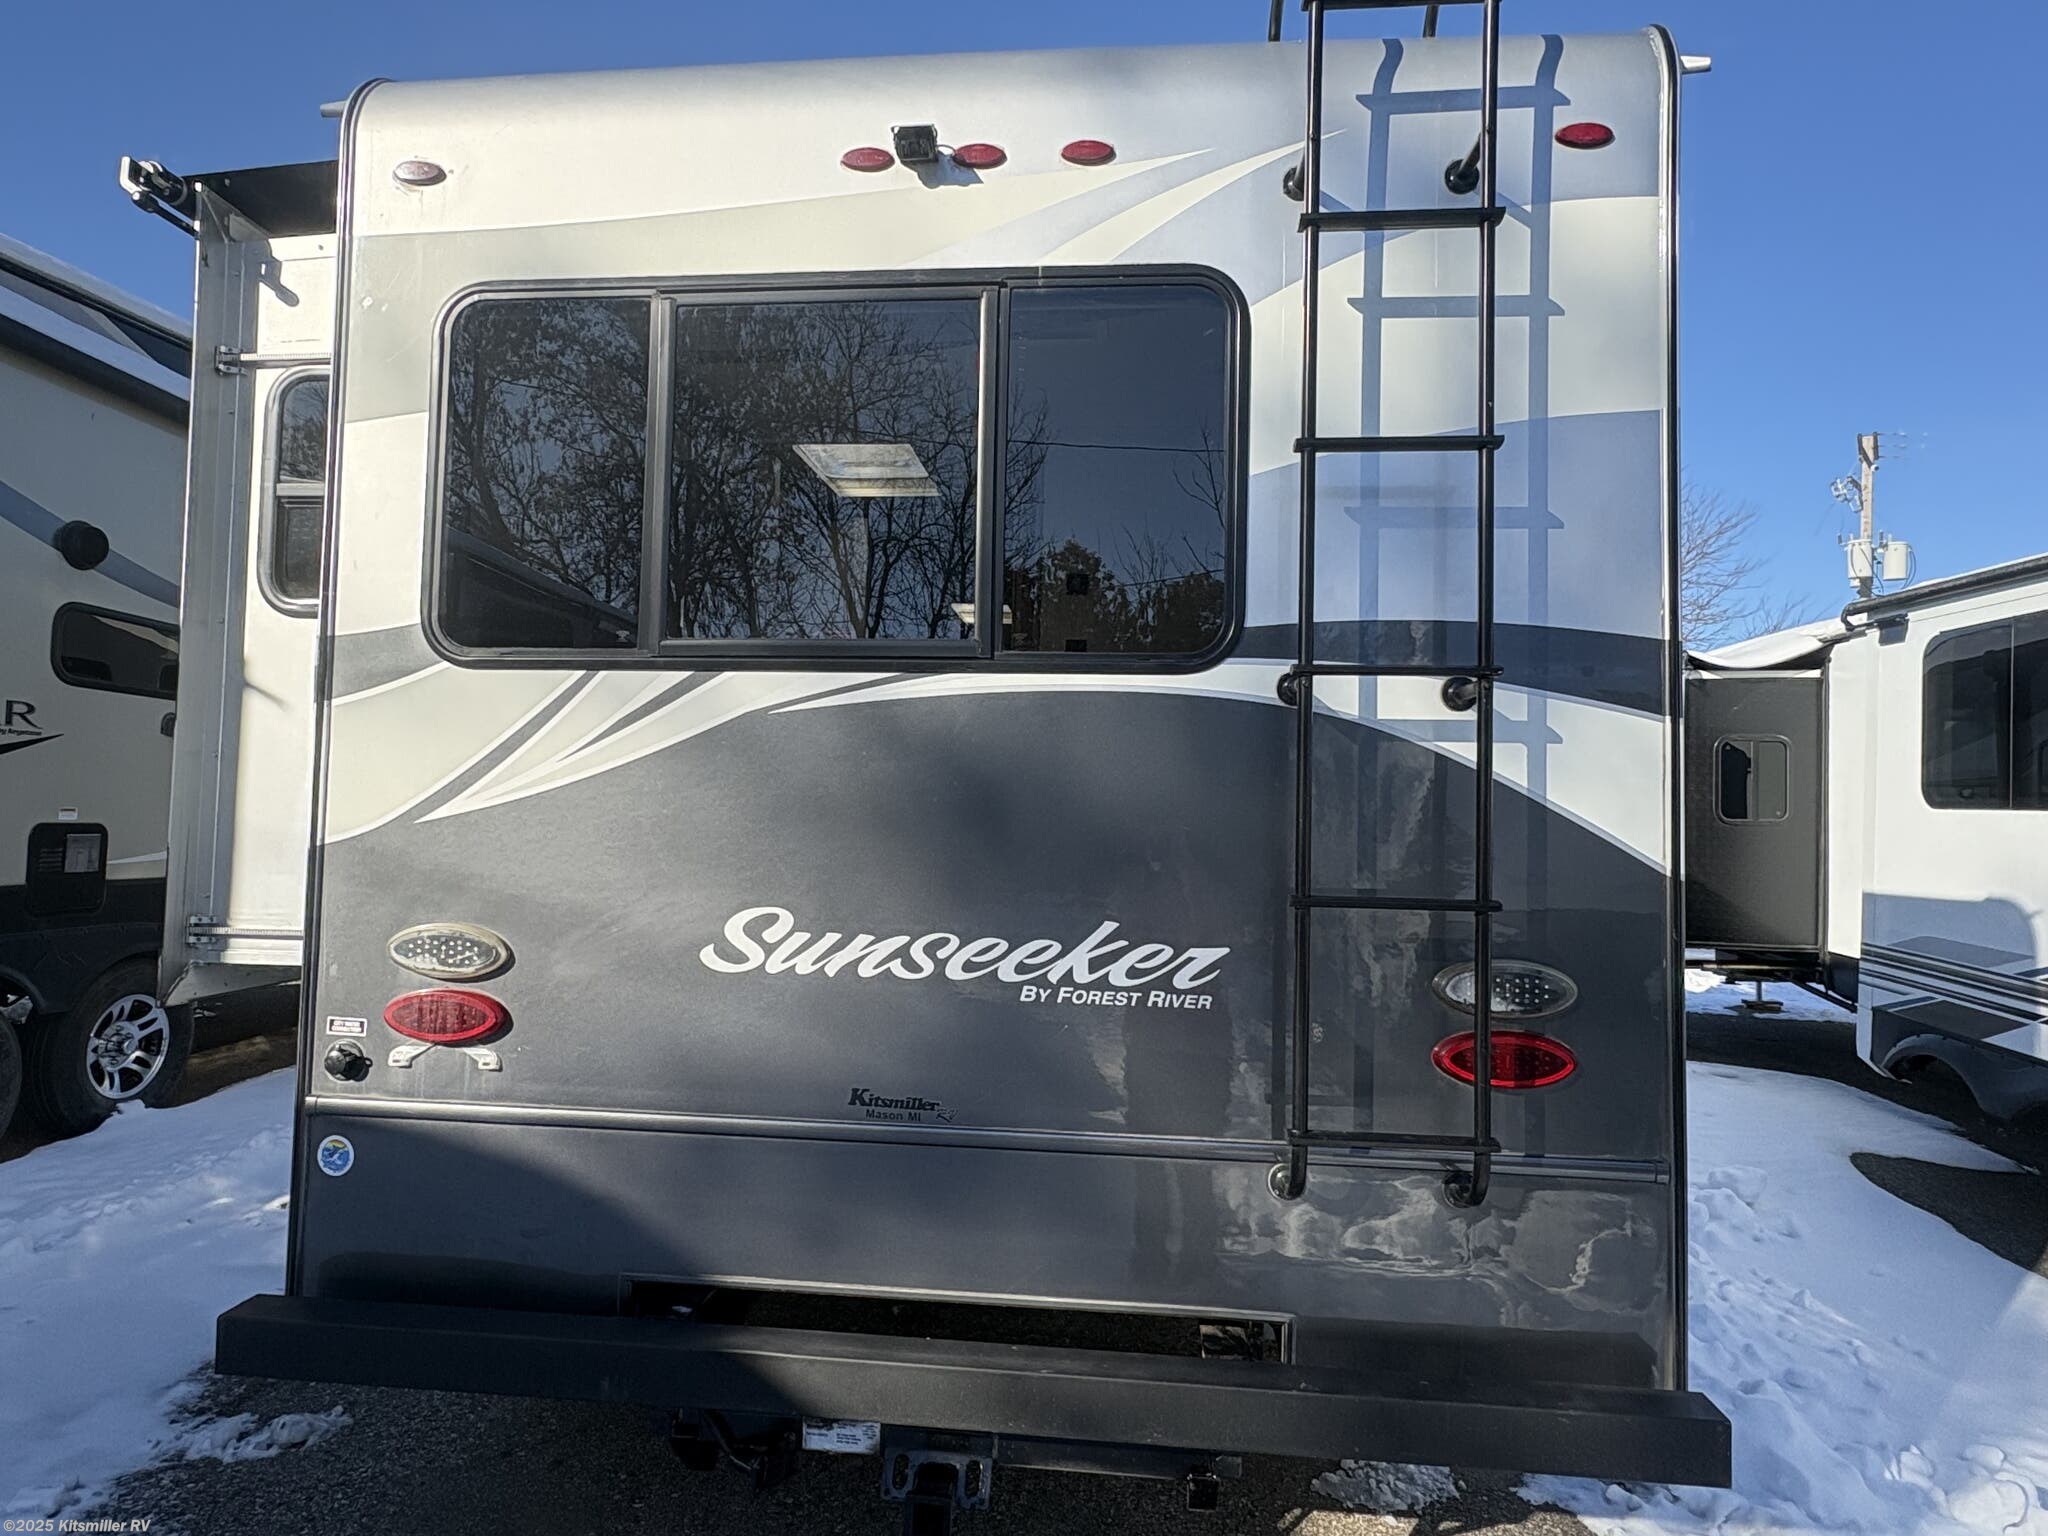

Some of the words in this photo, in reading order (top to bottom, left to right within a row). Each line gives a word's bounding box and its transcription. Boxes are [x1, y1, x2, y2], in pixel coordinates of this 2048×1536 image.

[0, 699, 43, 729] R
[699, 906, 1230, 990] Sunseeker
[1019, 985, 1052, 1003] BY
[1057, 987, 1142, 1007] FOREST
[1147, 990, 1213, 1010] RIVER
[848, 1088, 940, 1111] Kitsmiller
[865, 1109, 903, 1120] Mason
[907, 1111, 921, 1121] MI
